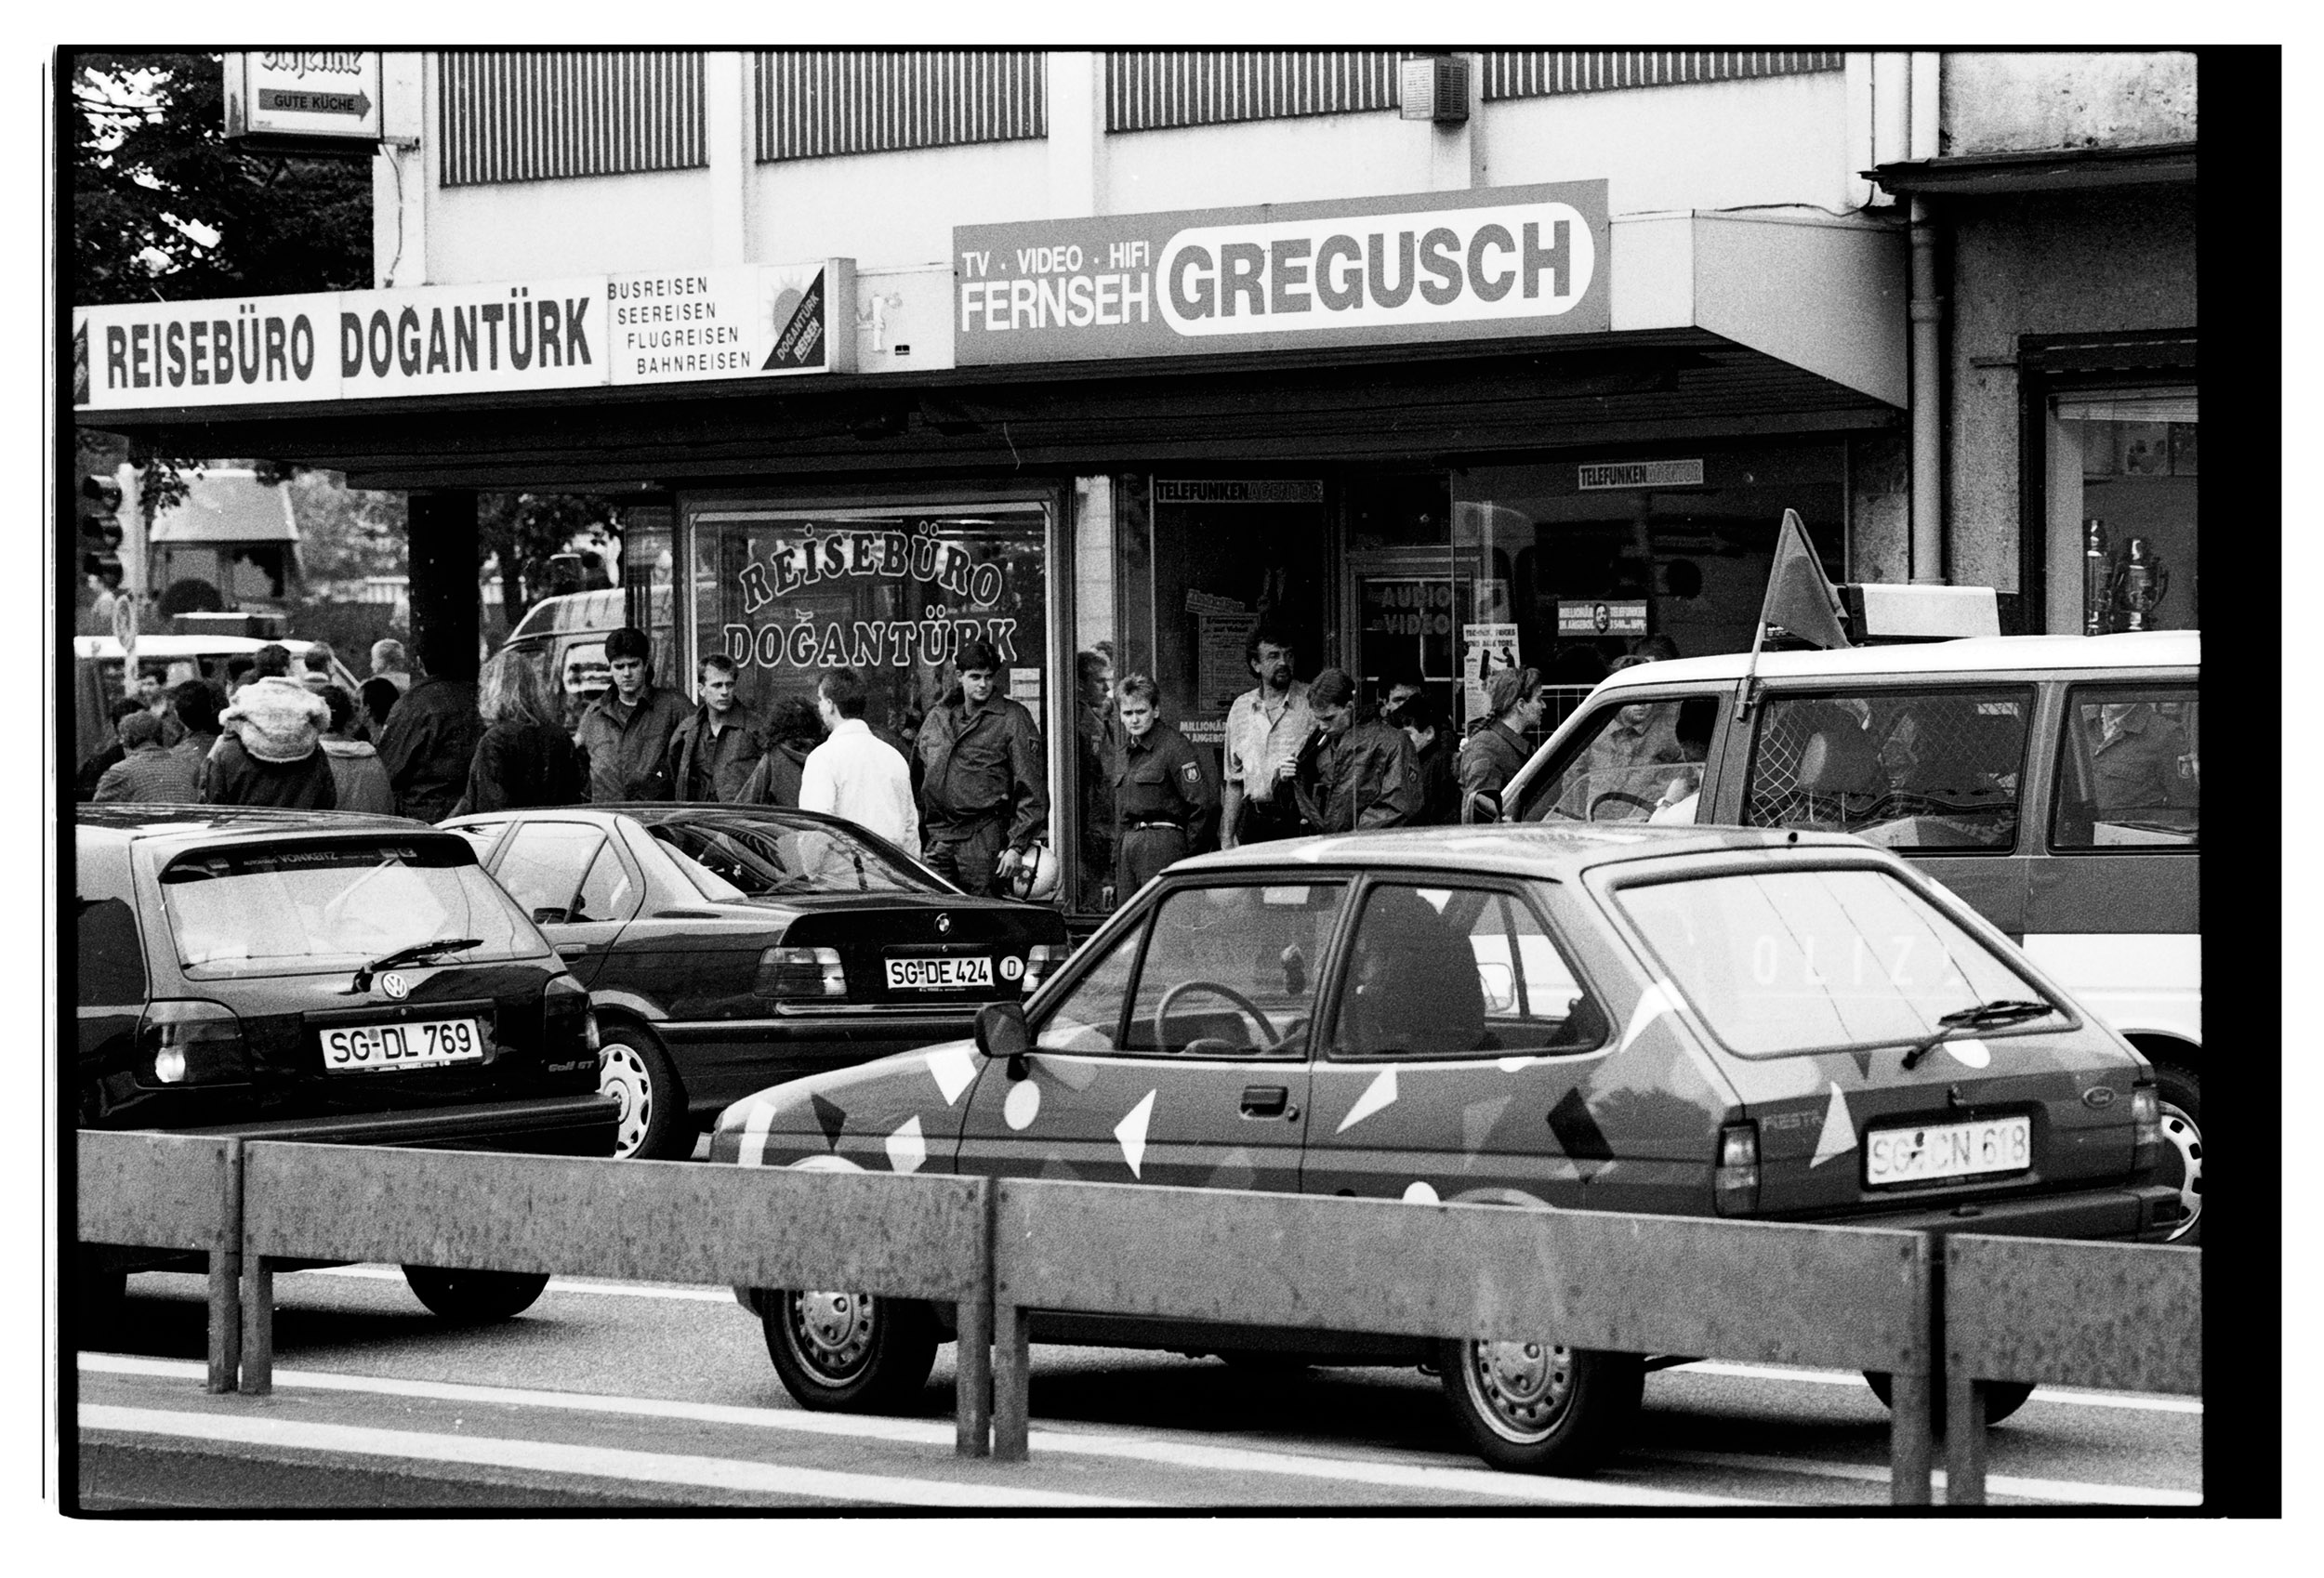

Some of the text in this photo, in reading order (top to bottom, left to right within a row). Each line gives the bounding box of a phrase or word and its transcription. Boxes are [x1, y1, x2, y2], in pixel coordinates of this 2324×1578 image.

[274, 95, 355, 111] GUTE KÜCHE
[961, 241, 1150, 276] TV VIDEO HIFI
[1168, 218, 1572, 322] GREGUSCH
[607, 276, 708, 300] BUSREISEN
[617, 301, 717, 325] SEEREISEN
[961, 272, 1150, 332] FERNSEH
[106, 286, 592, 388] REISEBÜRO DOĞANTÜRK
[627, 326, 739, 349] FLUGREISEN
[793, 316, 821, 361] REISEN
[637, 350, 751, 375] BAHNREISEN
[1580, 465, 1646, 486] TELEFUNKEN
[1156, 480, 1248, 502] TELEFUNKEN
[1381, 585, 1451, 608] AUDIO
[1383, 613, 1450, 635] VIDEO
[1192, 733, 1226, 743] ANGEBO
[891, 960, 988, 984] SG-DE 424
[1008, 960, 1016, 977] D
[330, 1023, 471, 1063] SG-DL 769
[1982, 1125, 2026, 1164] 618
